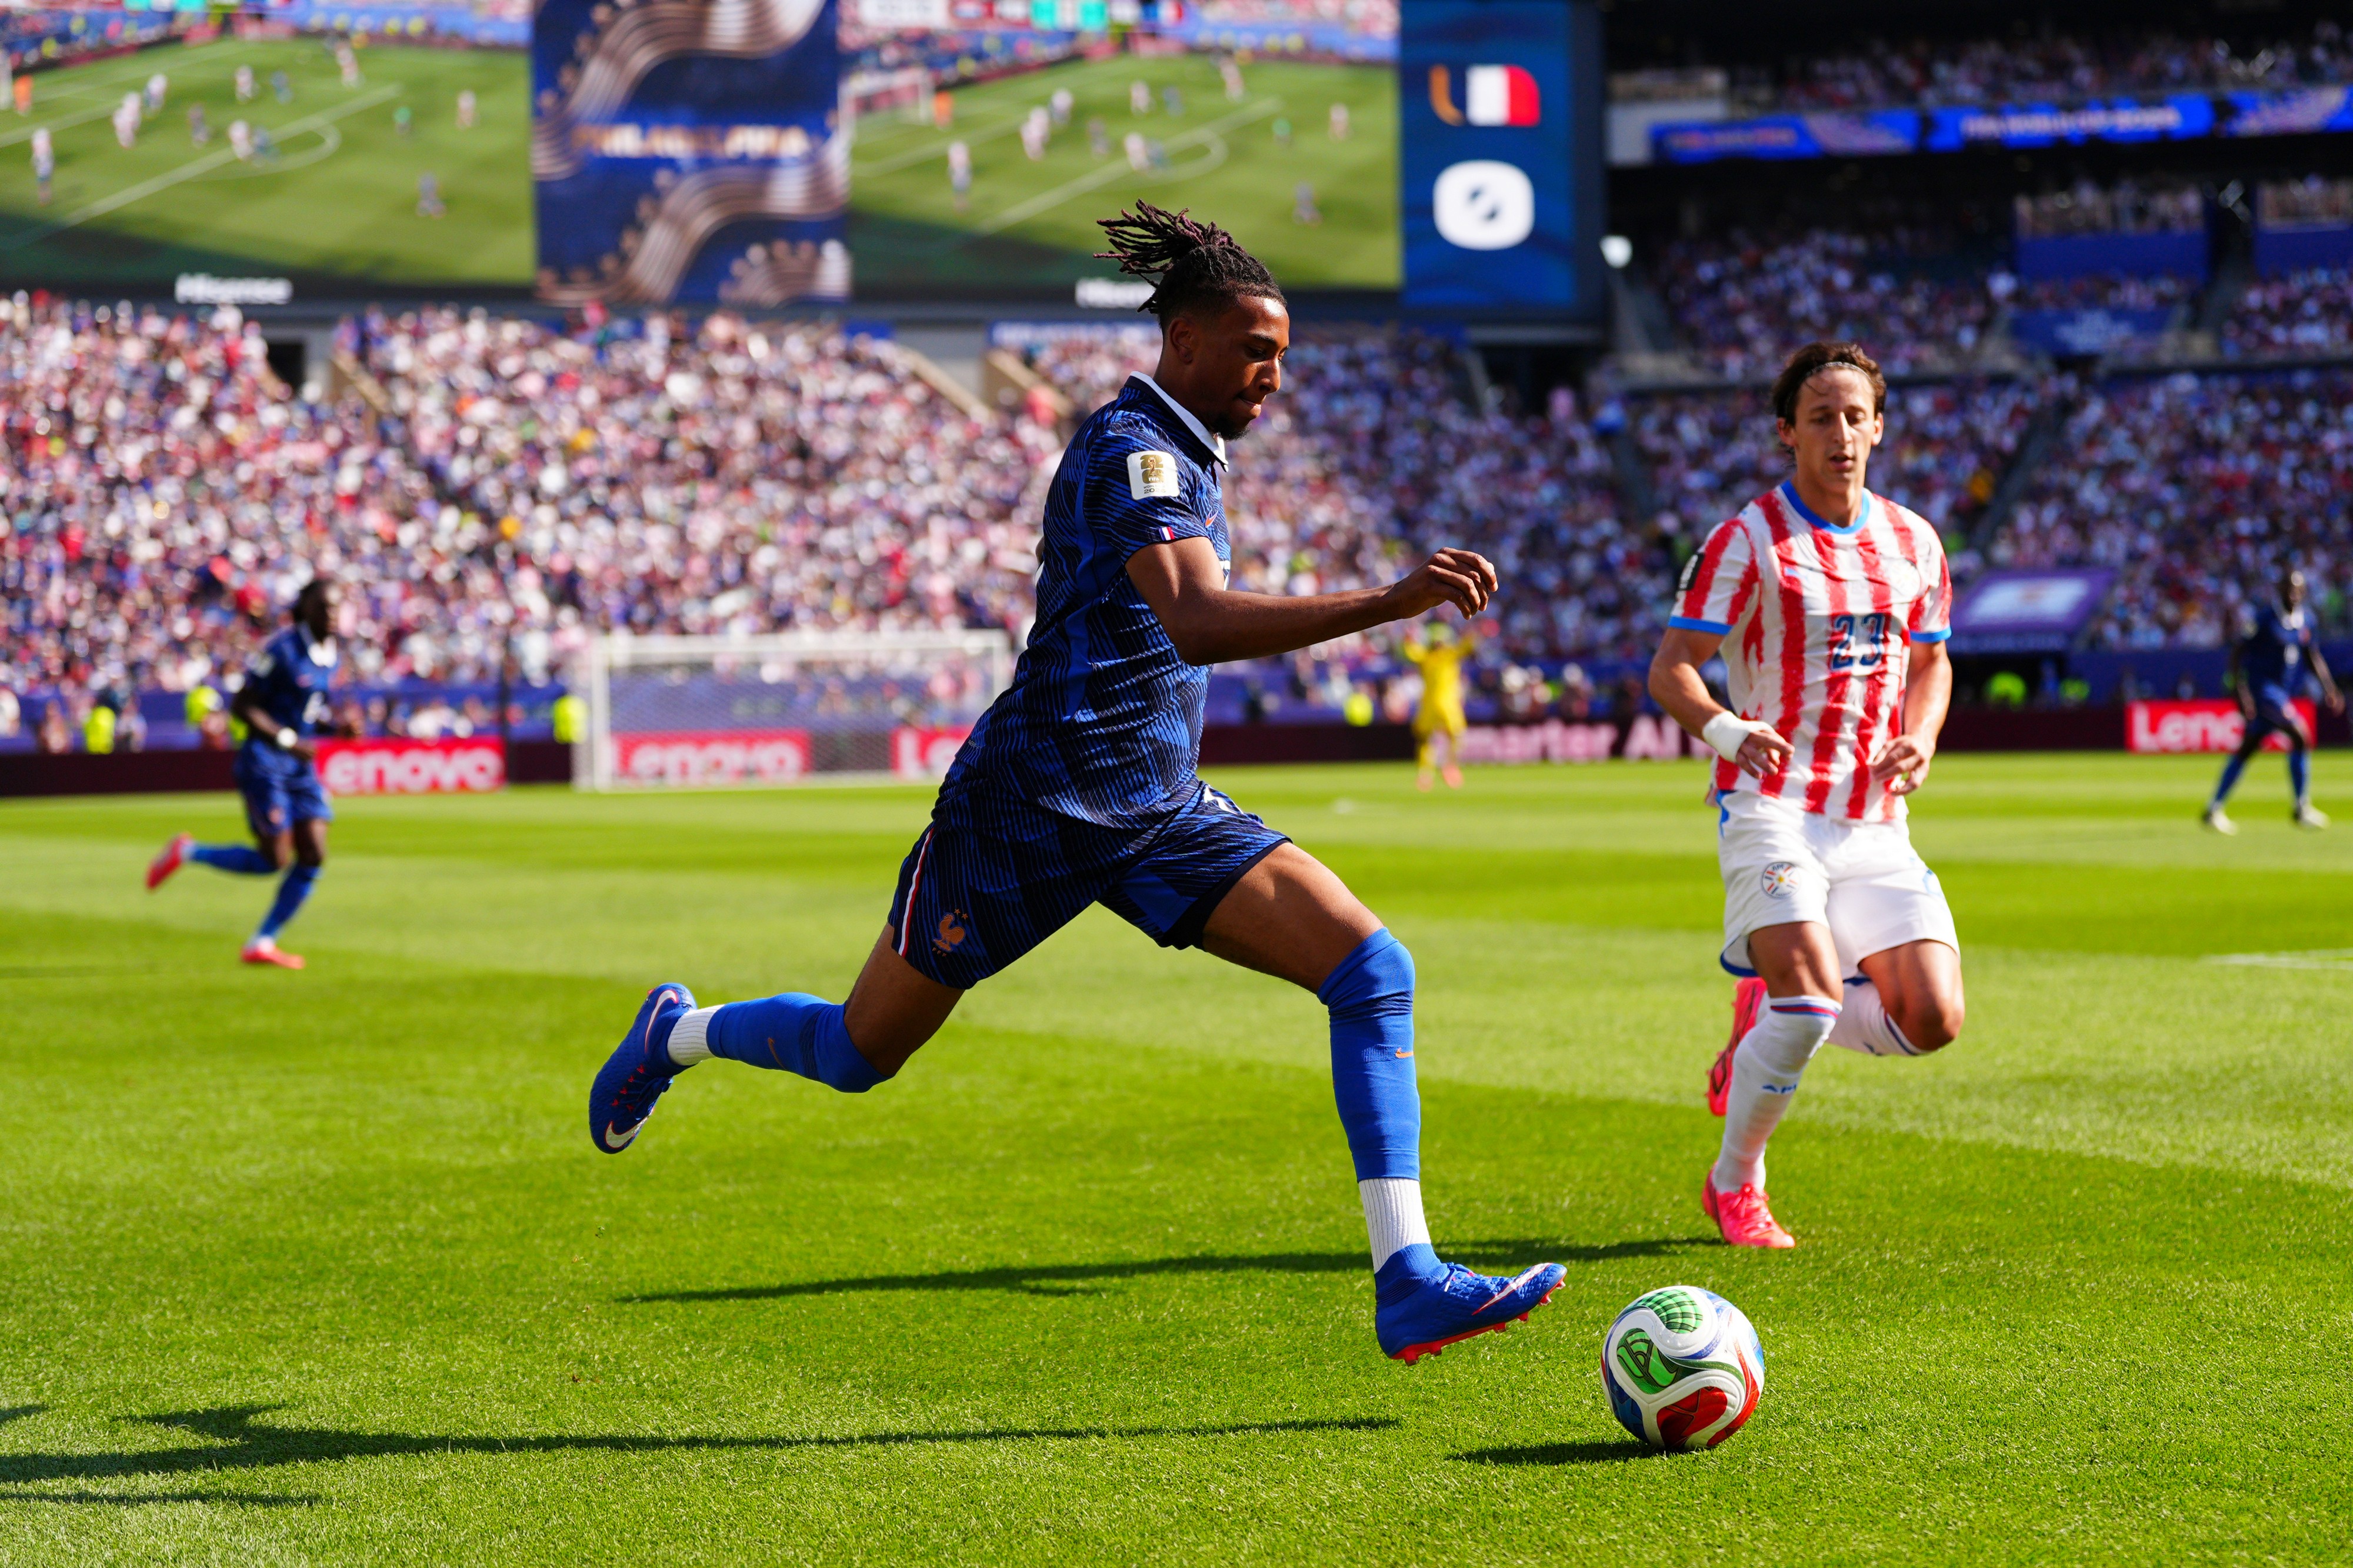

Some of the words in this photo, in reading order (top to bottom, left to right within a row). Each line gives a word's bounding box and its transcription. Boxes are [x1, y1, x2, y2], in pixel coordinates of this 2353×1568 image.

[1832, 613, 1886, 670] 23
[1458, 718, 1616, 763] marter
[2132, 702, 2290, 750] Leno
[325, 747, 504, 793] enovo
[627, 740, 804, 787] enovo
